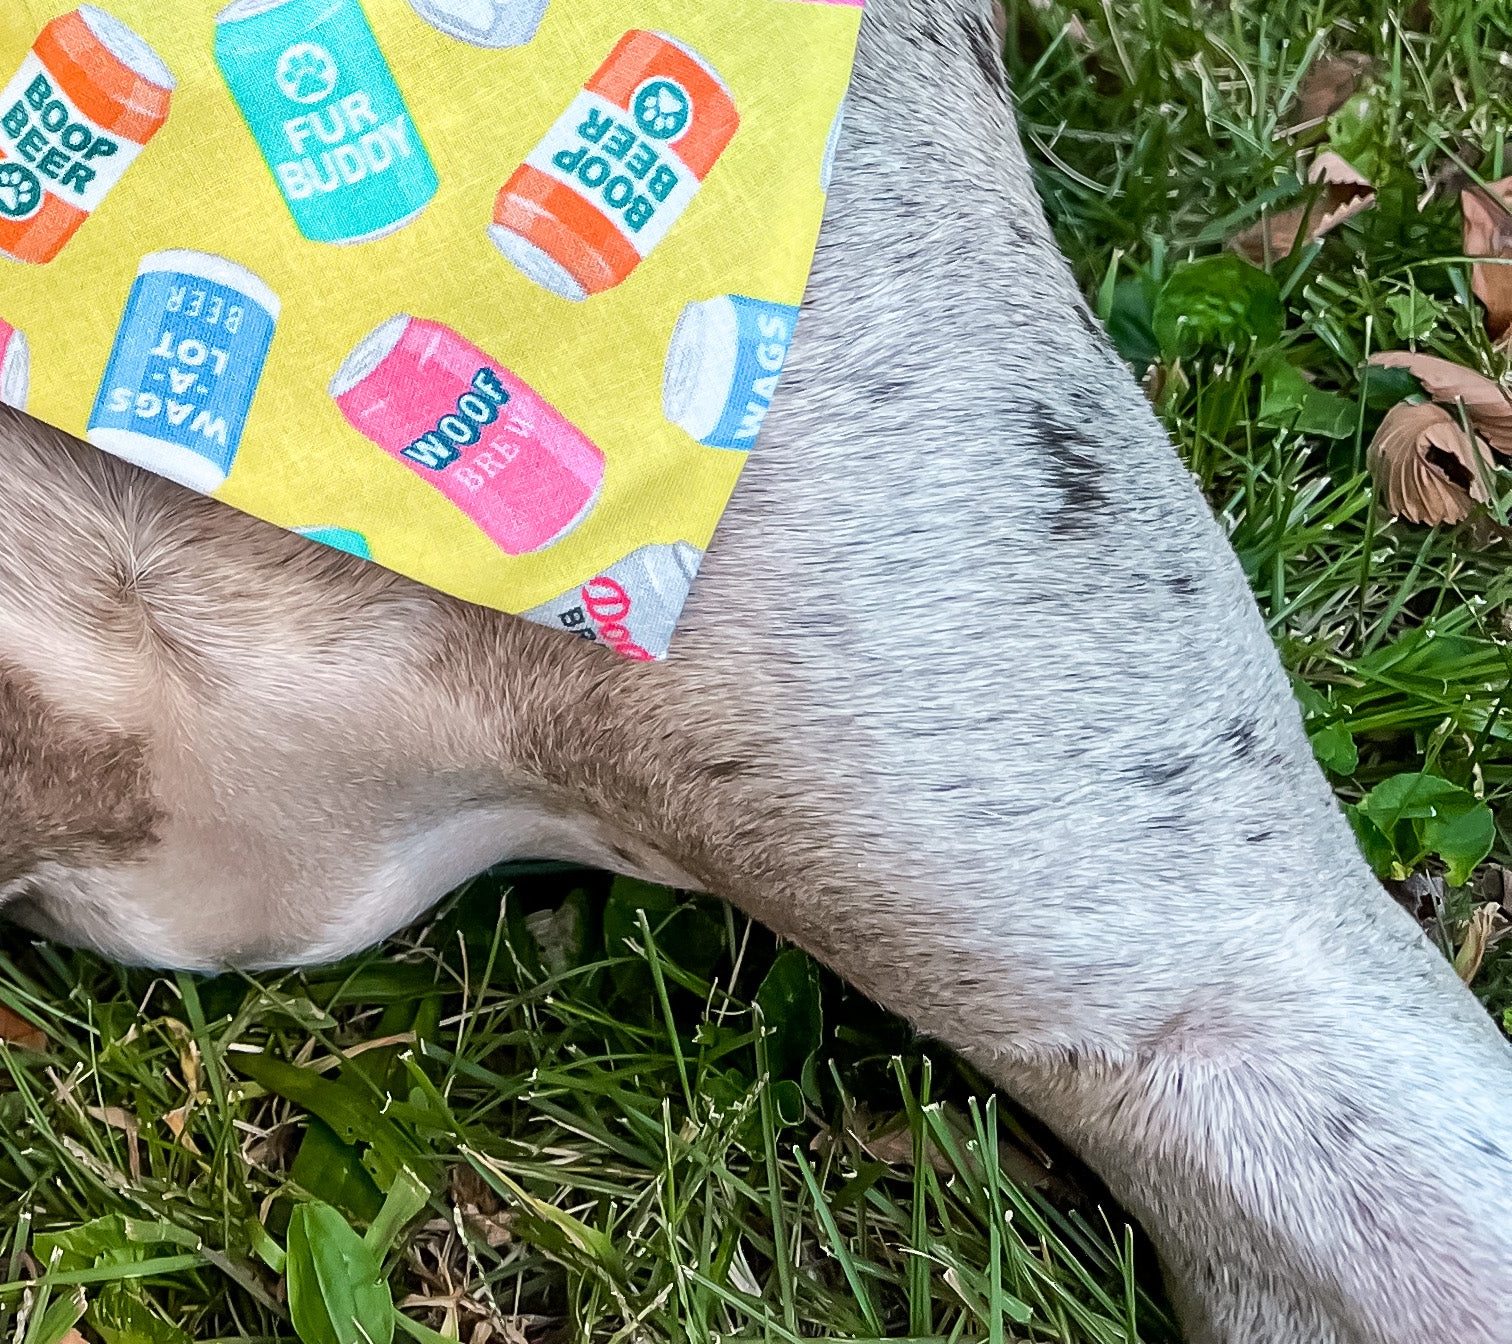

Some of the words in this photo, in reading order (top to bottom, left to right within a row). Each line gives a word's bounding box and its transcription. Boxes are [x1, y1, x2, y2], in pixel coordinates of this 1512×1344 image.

[1, 99, 96, 195] BEER
[24, 72, 118, 161] BOOP
[277, 112, 411, 200] BUDDY
[284, 90, 378, 154] FUR
[577, 107, 678, 202] BEER
[552, 146, 654, 233] BOOP
[149, 330, 229, 376] LOT
[166, 286, 244, 335] BEER
[108, 387, 227, 447] WAGS
[400, 366, 511, 471] WOOF
[734, 313, 787, 440] WAGS
